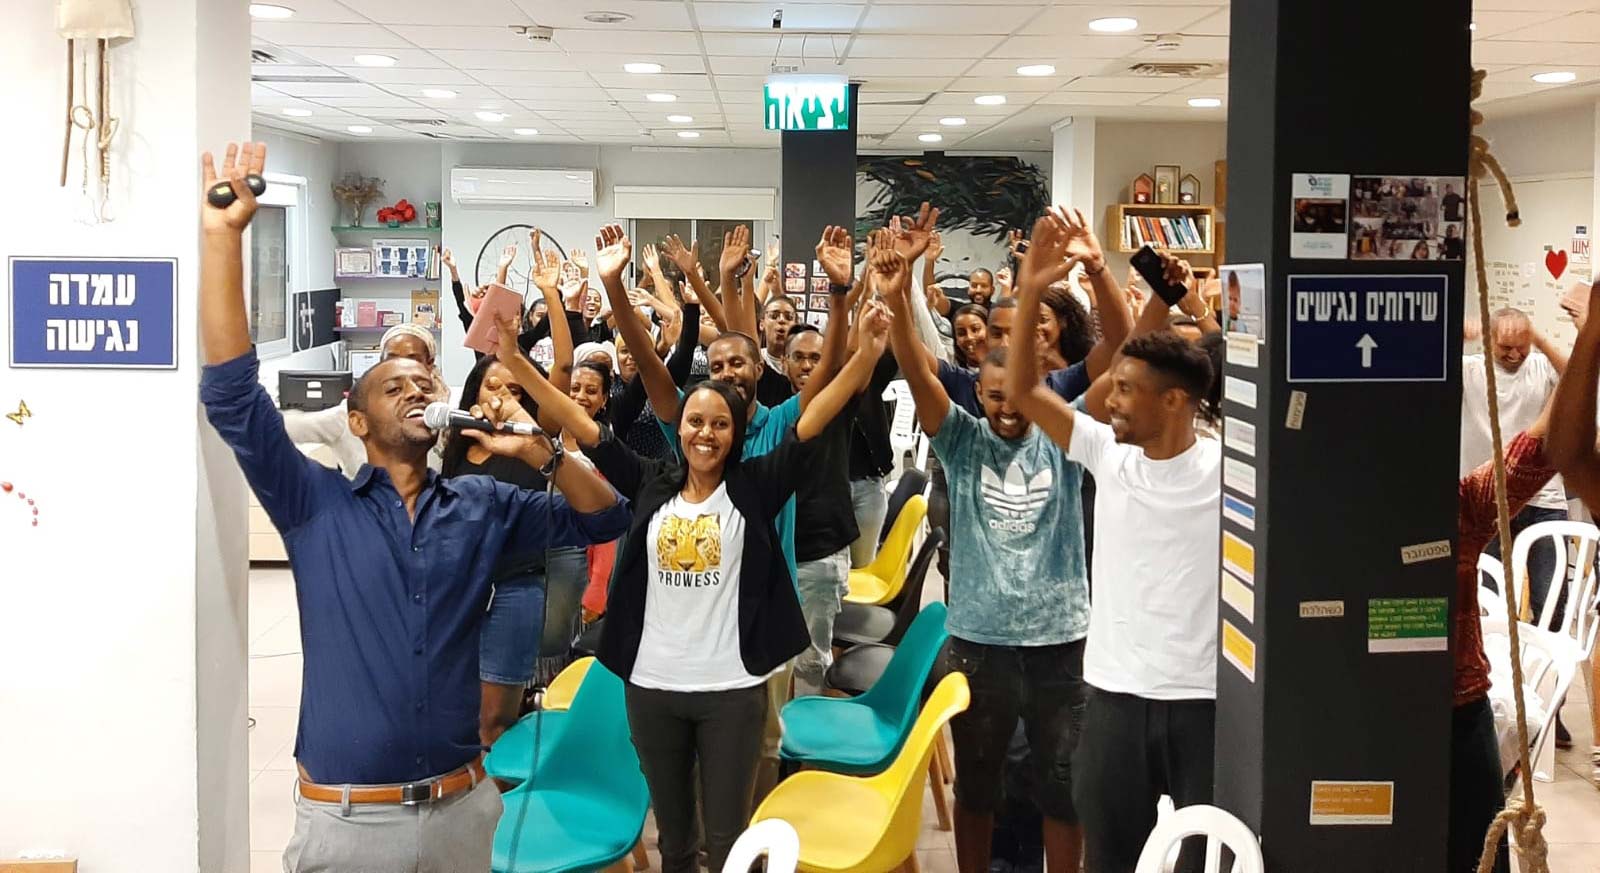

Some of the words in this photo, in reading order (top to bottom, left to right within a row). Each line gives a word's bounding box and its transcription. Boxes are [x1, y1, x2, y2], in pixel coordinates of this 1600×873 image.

[768, 82, 845, 129] יציאה
[49, 273, 136, 306] עמדה
[1296, 291, 1357, 322] נגישים
[1366, 291, 1438, 322] שירותים
[46, 319, 139, 352] נגישה
[988, 519, 1036, 534] adidas
[1403, 543, 1450, 561] ספטמבר
[658, 571, 721, 587] PROWESS
